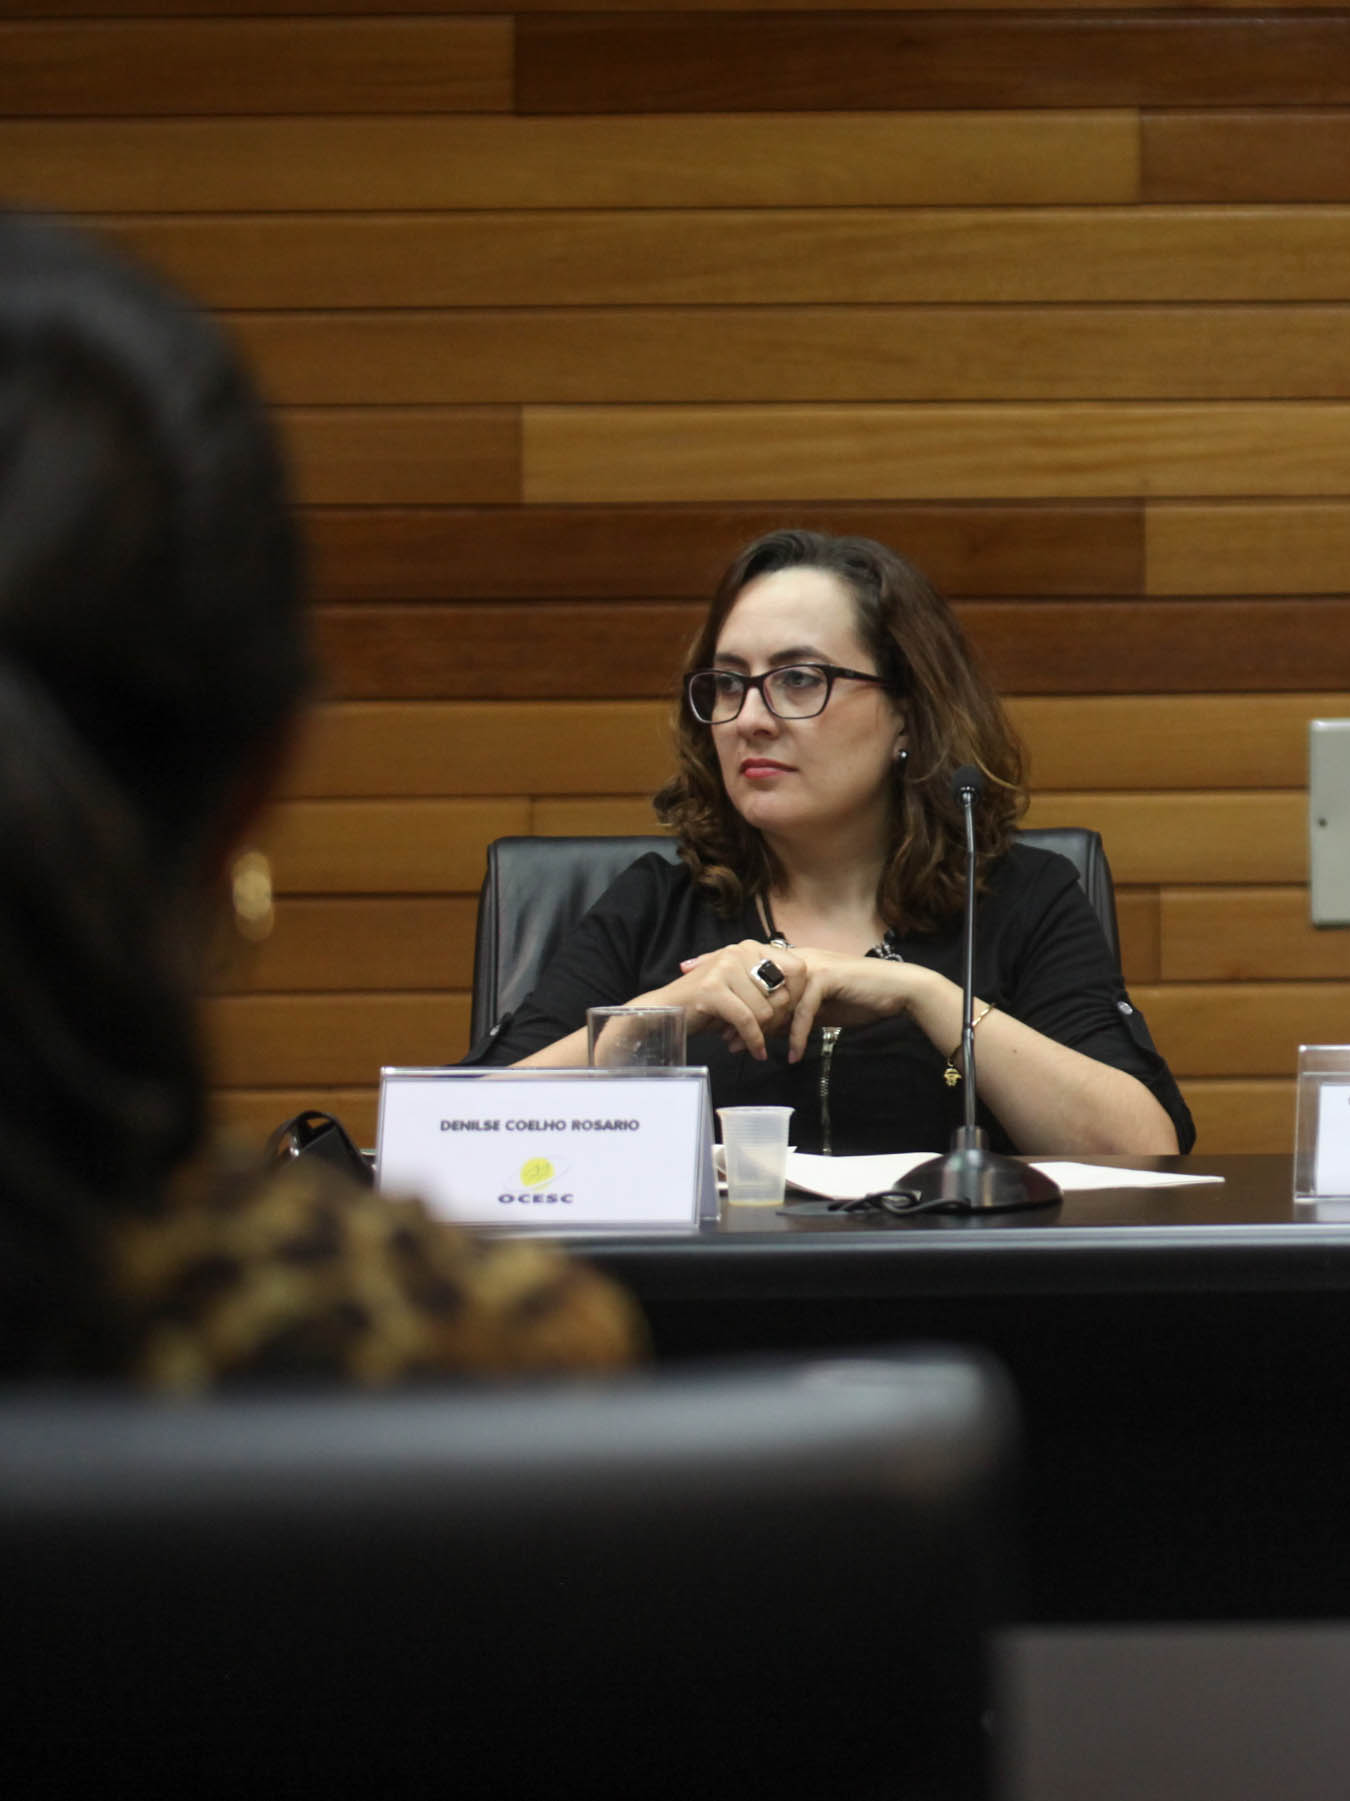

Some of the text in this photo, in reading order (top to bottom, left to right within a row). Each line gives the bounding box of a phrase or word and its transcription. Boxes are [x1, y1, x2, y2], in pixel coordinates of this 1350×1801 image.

[440, 1119, 640, 1131] DENILSE COELHO ROSARIO
[498, 1193, 574, 1204] OCESC
